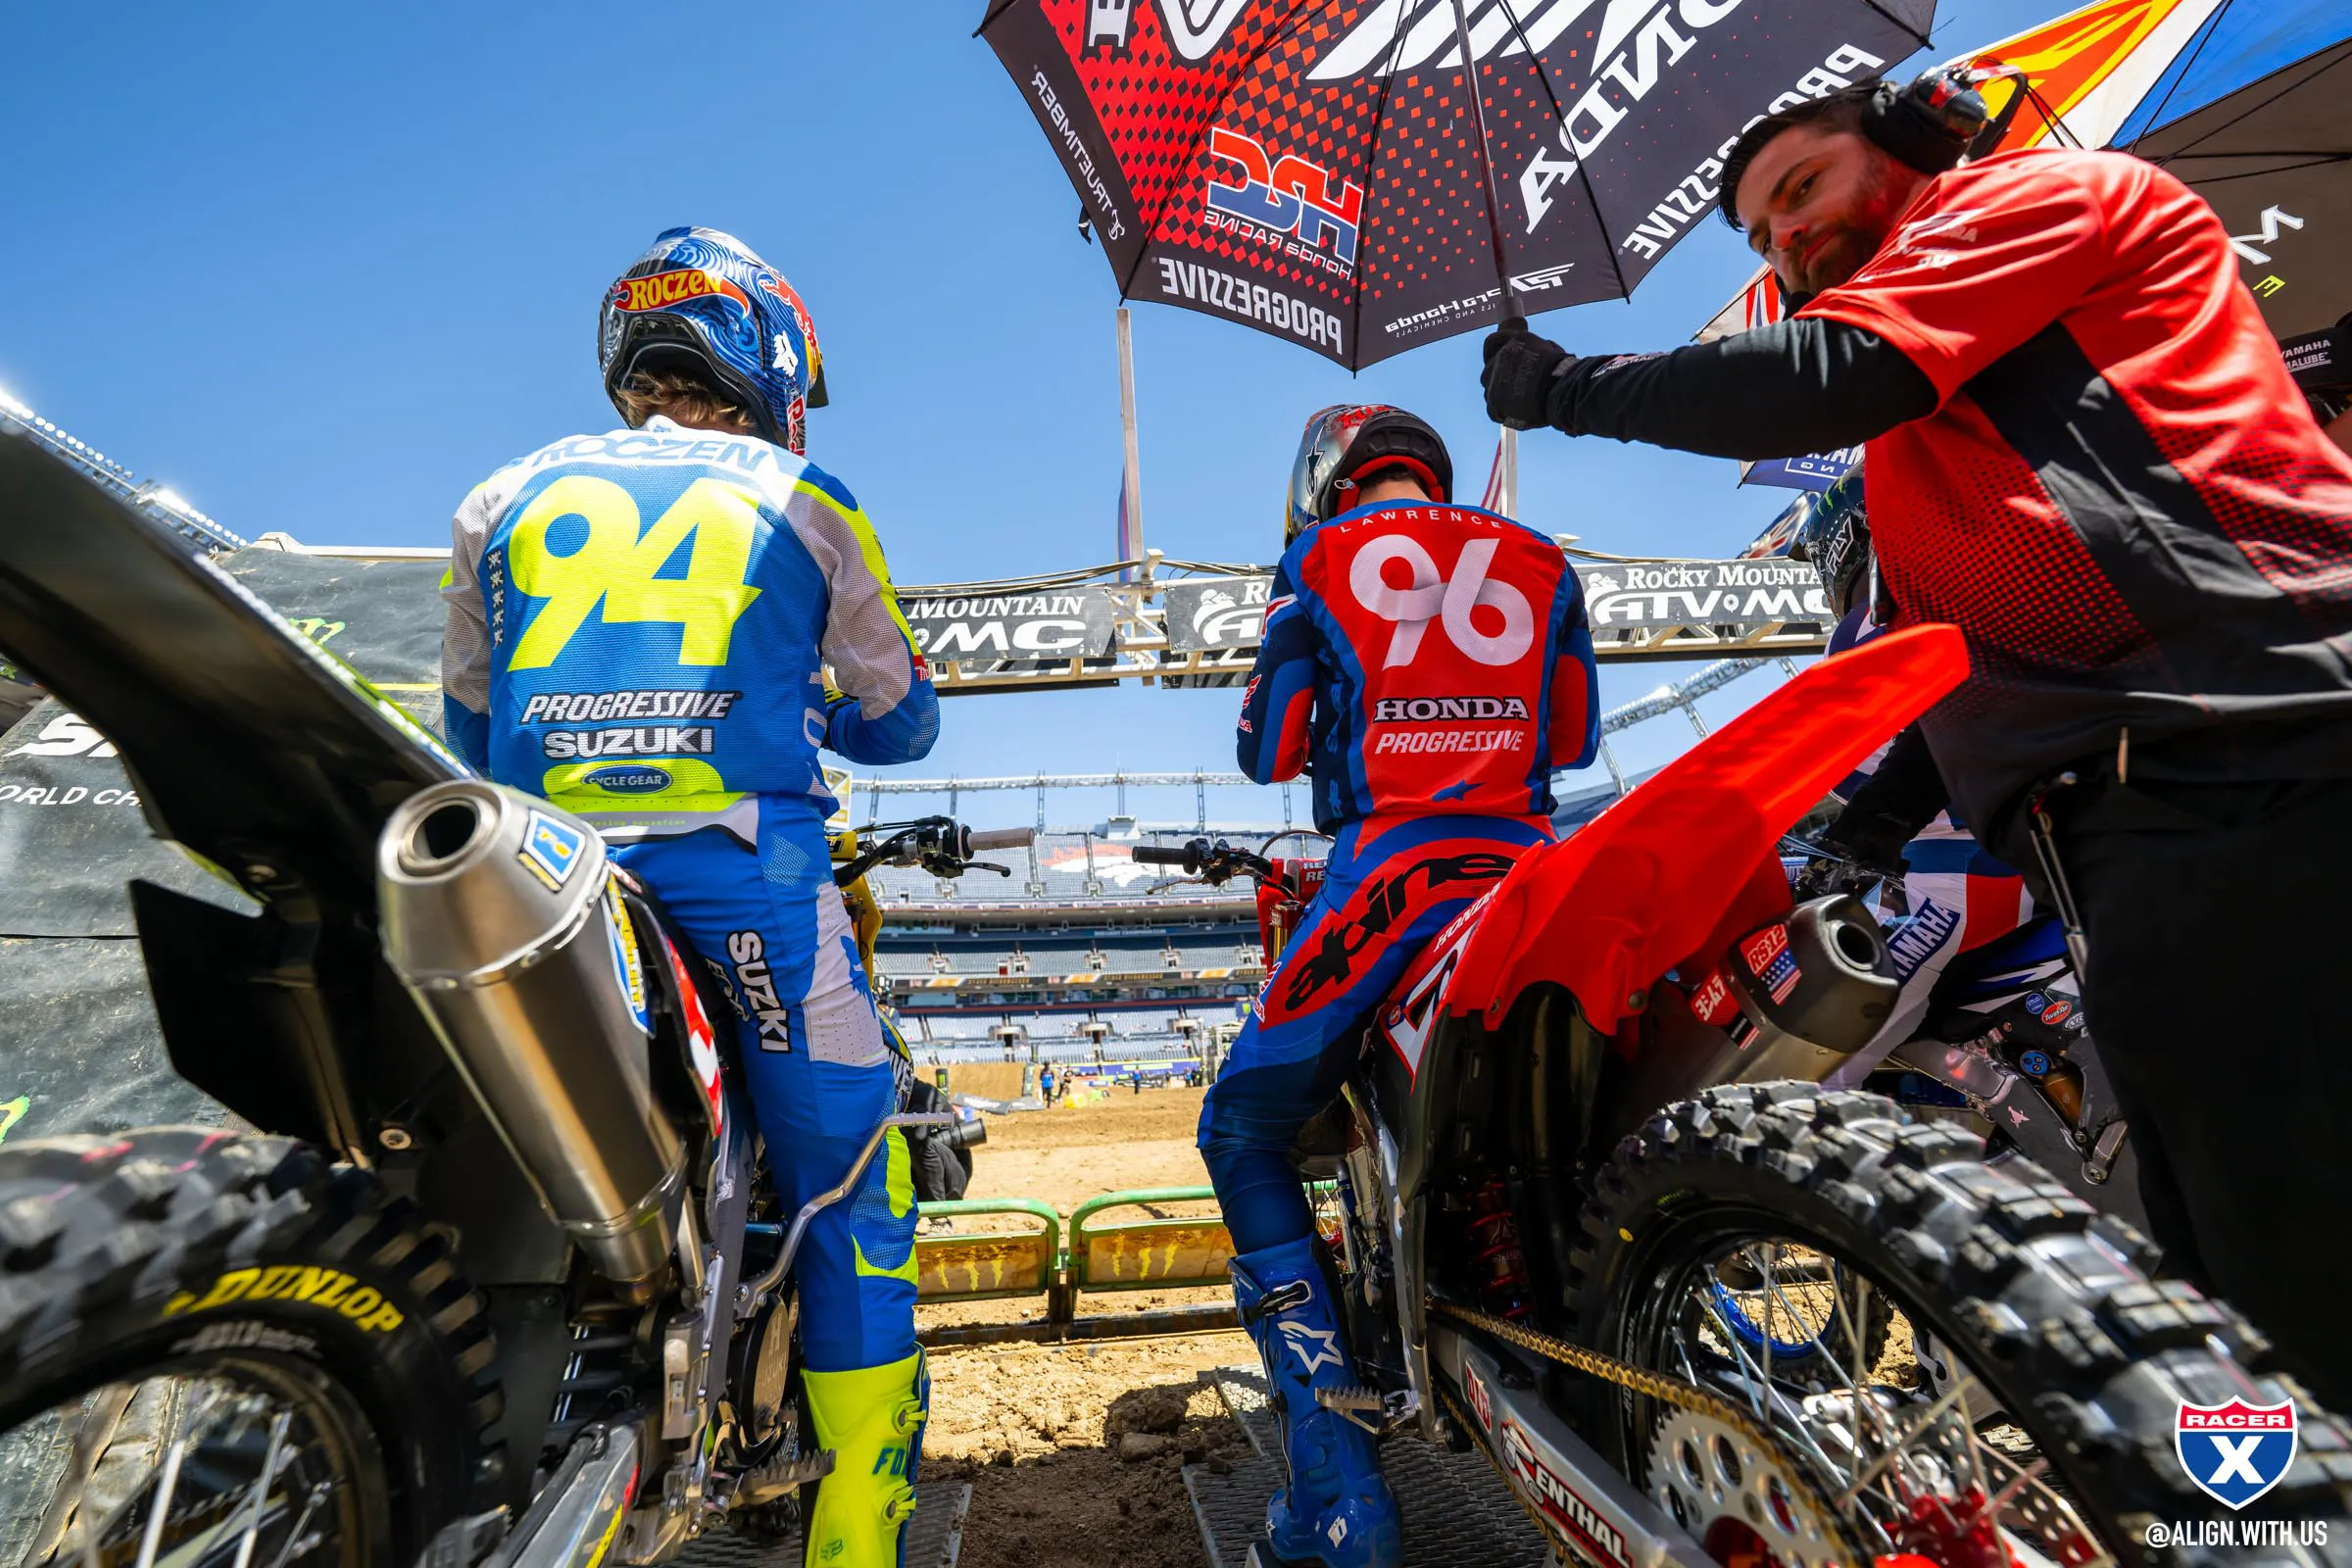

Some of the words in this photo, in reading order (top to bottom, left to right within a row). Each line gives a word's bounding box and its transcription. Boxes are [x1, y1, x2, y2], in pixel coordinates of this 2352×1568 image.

[2281, 339, 2331, 366] YAMAHA
[532, 434, 771, 470] ROCZEN
[1340, 509, 1502, 534] LAWRENCE
[1826, 515, 1854, 576] FLY
[508, 475, 762, 671] 94
[1625, 565, 1712, 590] ROCKY
[907, 595, 1085, 619] MOUNTAIN
[1349, 534, 1534, 671] 96
[521, 692, 735, 725] PROGRESSIVE
[1374, 698, 1528, 721] HONDA
[545, 728, 713, 759] SUZUKI
[1375, 729, 1525, 755] PROGRESSIVE
[589, 776, 627, 786] CYCLE
[627, 775, 662, 786] GEAR
[1433, 880, 1502, 953] HONDA
[163, 1265, 405, 1332] DUNLOP
[1502, 1424, 1631, 1568] RENTHAL
